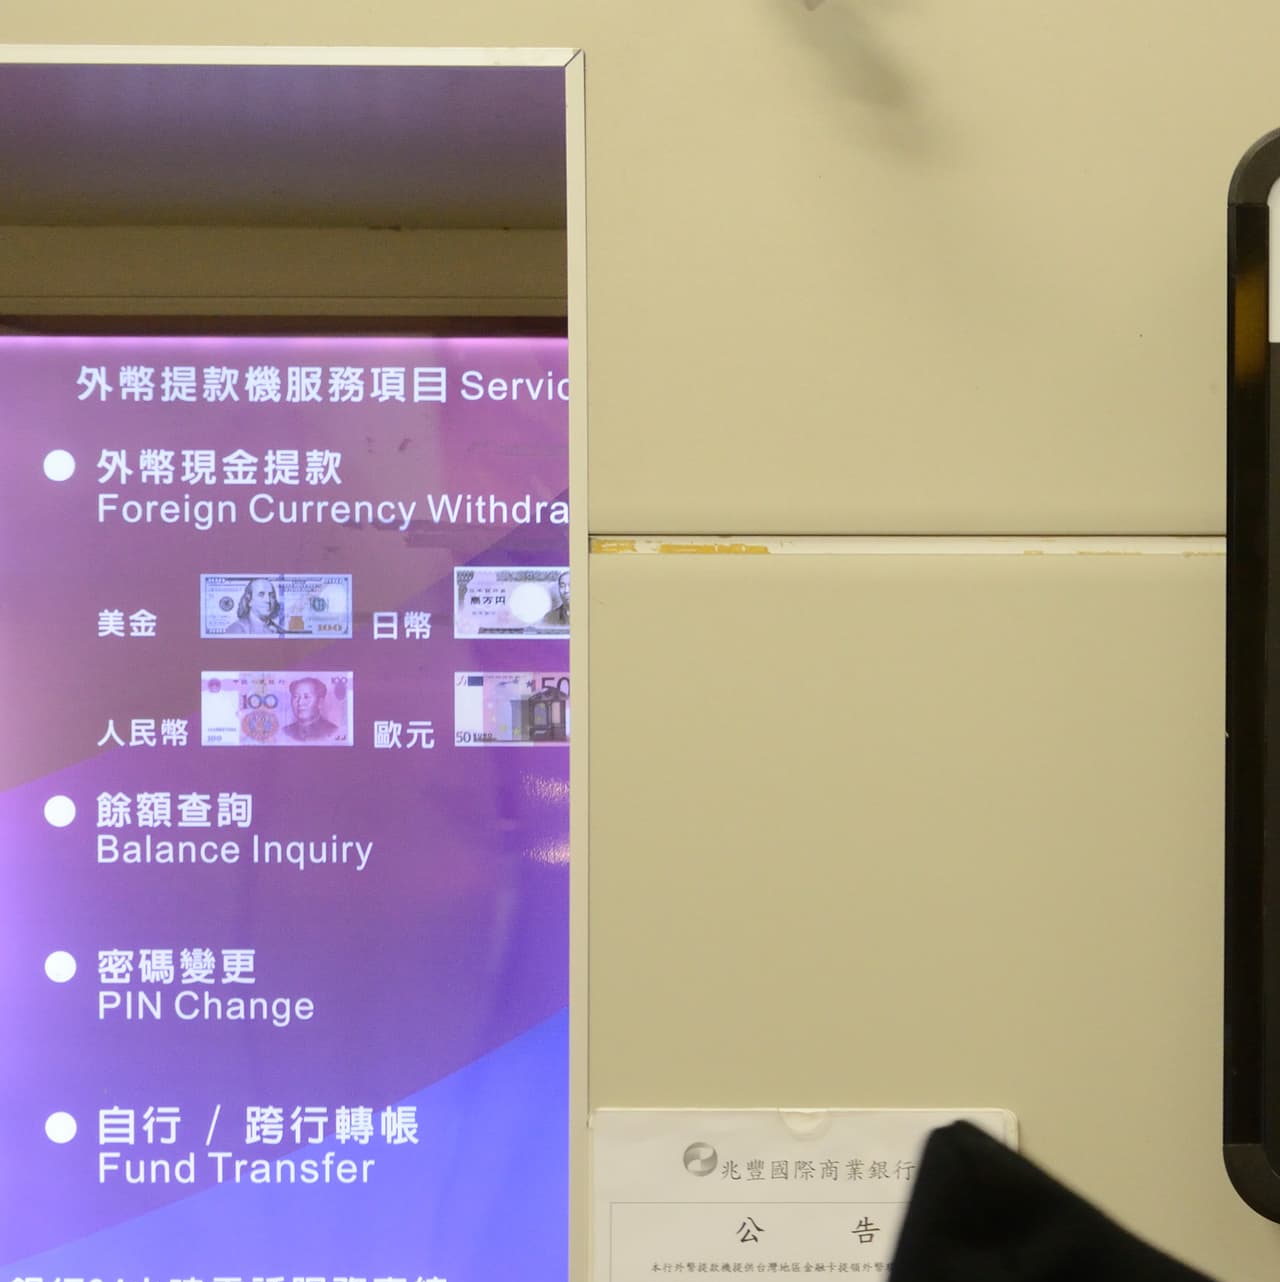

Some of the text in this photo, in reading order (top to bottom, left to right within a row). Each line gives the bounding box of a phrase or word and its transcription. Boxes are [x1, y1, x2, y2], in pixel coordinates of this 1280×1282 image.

[76, 366, 447, 403] 外幣提款機服務項目
[97, 449, 342, 485] 外幣現金提款
[97, 494, 236, 530] Foreign
[248, 493, 417, 530] Currency
[97, 609, 157, 637] 美金
[372, 610, 432, 641] 日幣
[97, 718, 189, 747] 人民幣
[373, 720, 435, 749] 歐元
[97, 792, 253, 828] 餘額查詢
[97, 834, 373, 870] Balance Inquiry
[97, 949, 256, 985] 密碼變更
[98, 991, 314, 1027] PIN Change
[98, 1105, 181, 1145] 自行
[245, 1105, 419, 1145] 跨行轉帳
[98, 1151, 375, 1185] Fund Transfer
[721, 1158, 916, 1183] 兆豐國際商業銀行
